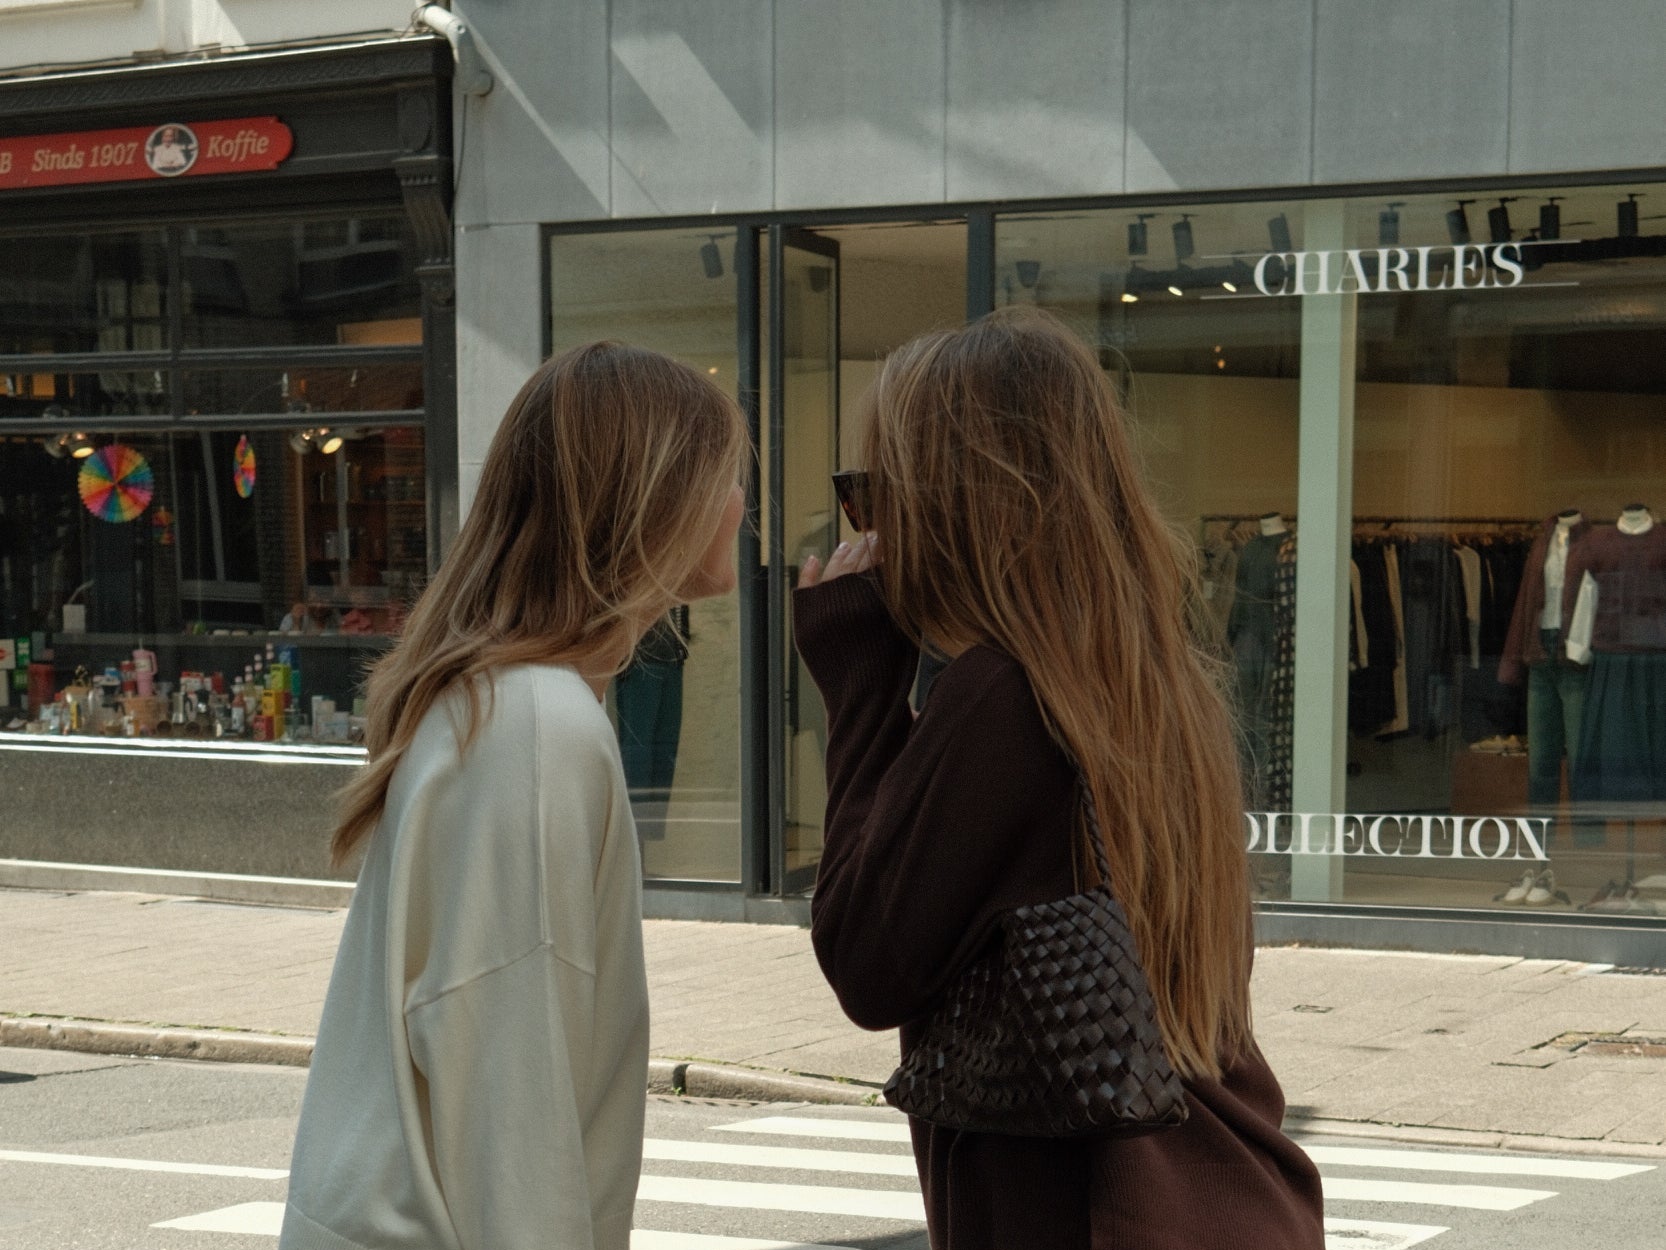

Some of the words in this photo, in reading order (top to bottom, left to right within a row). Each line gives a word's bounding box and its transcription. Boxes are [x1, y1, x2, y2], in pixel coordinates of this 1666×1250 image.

[32, 144, 84, 172] Sinds
[90, 142, 139, 168] 1907
[206, 129, 270, 163] Koffie
[1253, 243, 1524, 296] CHARLES
[1243, 812, 1552, 861] LLECTION
